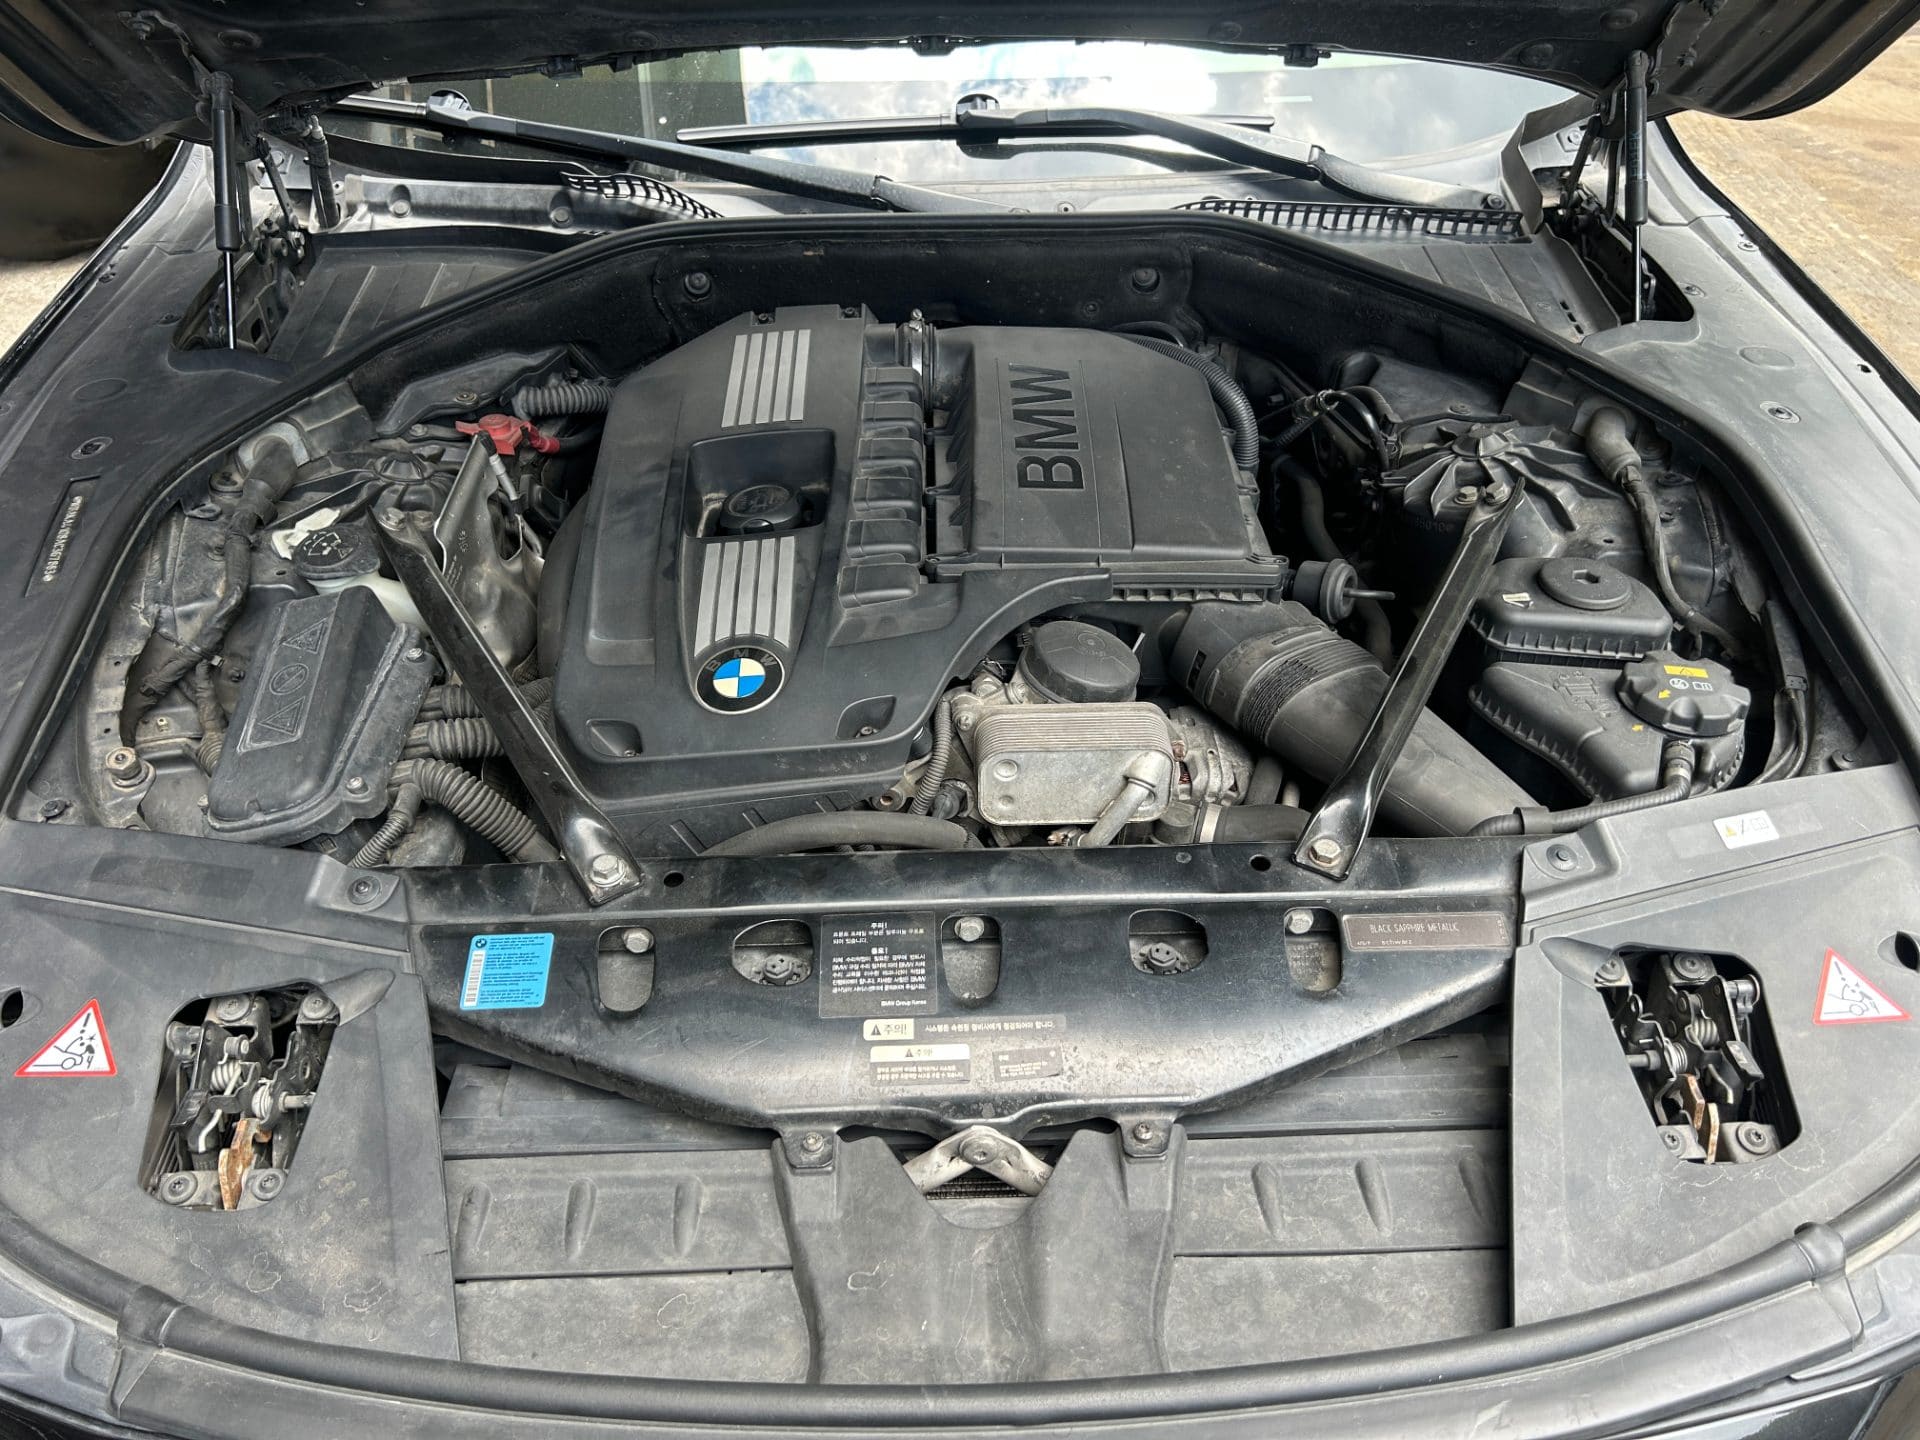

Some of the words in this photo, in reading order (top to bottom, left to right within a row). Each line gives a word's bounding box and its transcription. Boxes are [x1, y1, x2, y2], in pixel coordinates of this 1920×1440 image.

[1008, 362, 1085, 489] BMW
[705, 648, 778, 673] BMW
[1370, 924, 1392, 933] BLACK
[1394, 924, 1425, 933] SAPPHIRE
[1427, 922, 1459, 932] METALLIC
[884, 1024, 907, 1035] 주의!
